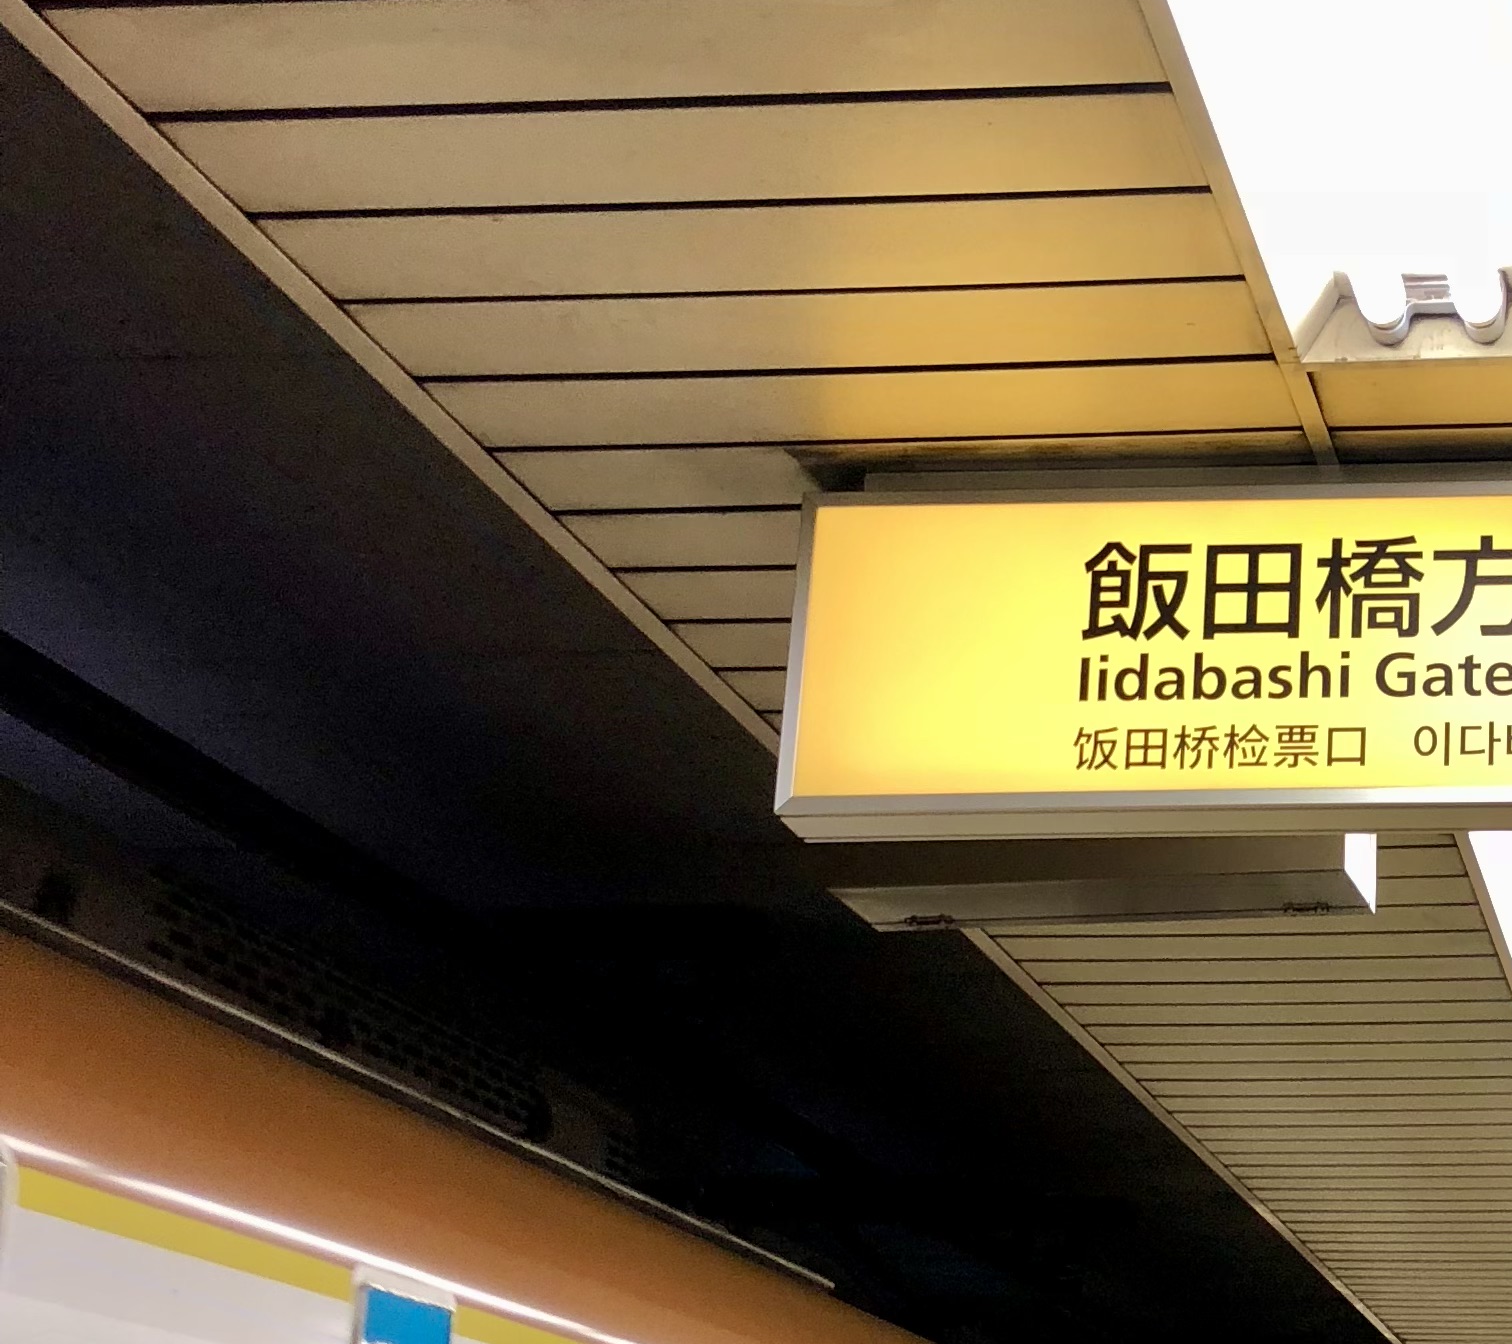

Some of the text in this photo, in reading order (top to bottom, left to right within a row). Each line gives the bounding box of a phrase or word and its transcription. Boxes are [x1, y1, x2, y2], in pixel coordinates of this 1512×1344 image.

[1079, 651, 1350, 701] Iidabashi
[1073, 723, 1366, 770] 饭田桥检票口
